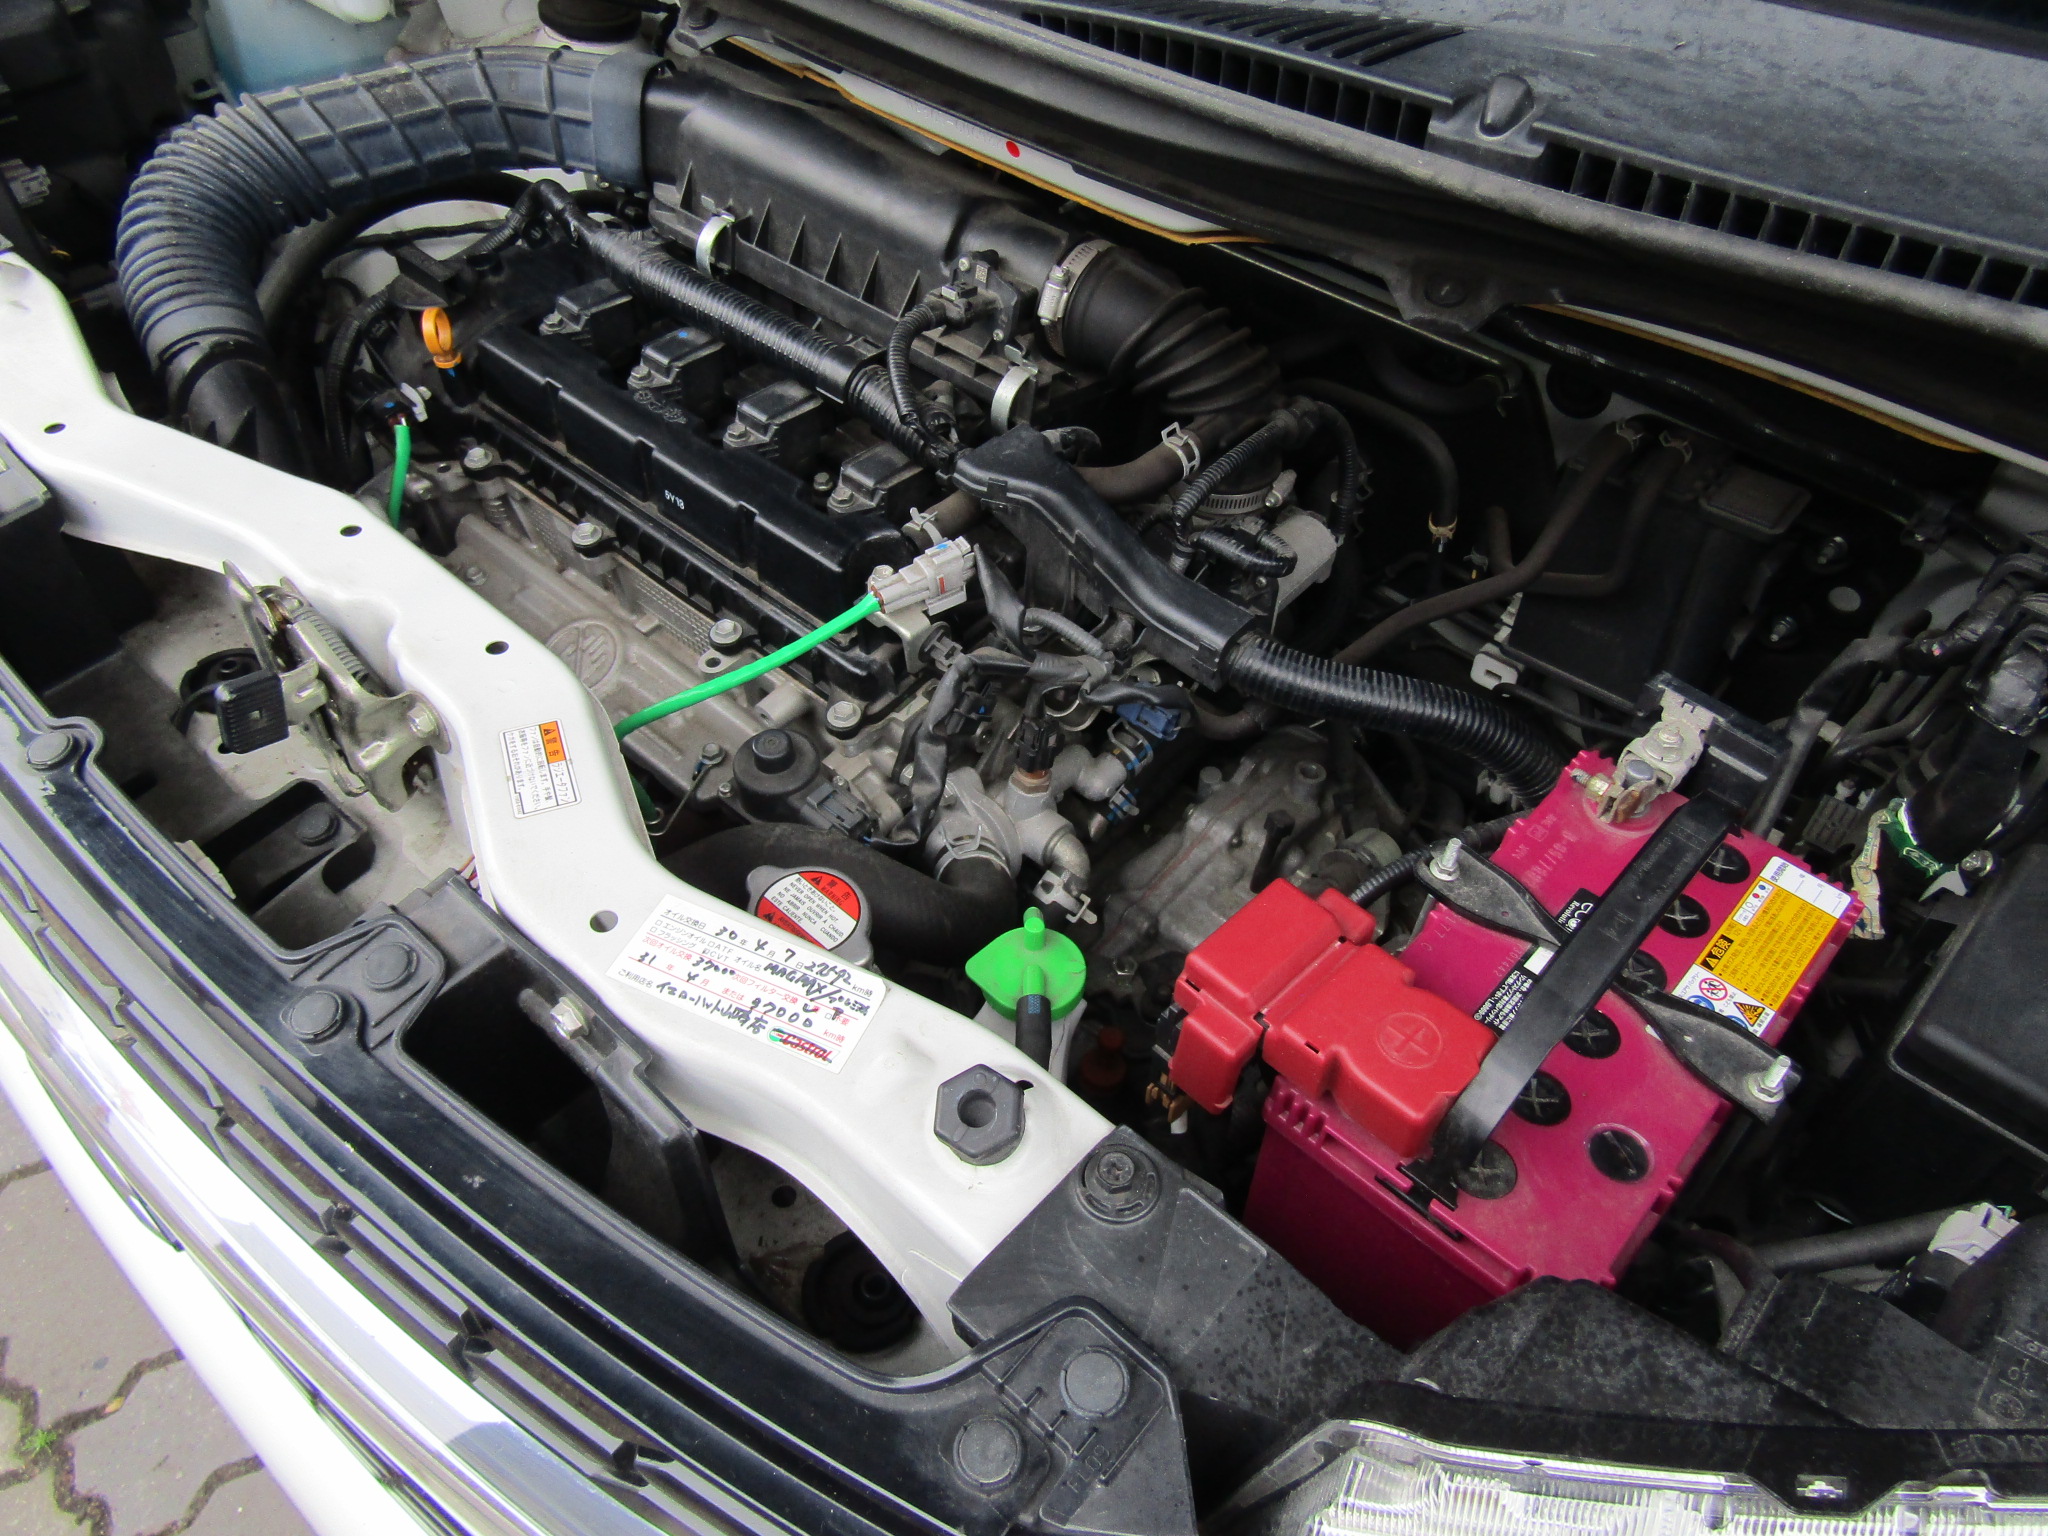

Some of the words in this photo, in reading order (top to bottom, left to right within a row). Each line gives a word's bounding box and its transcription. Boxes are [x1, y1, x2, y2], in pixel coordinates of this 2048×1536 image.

[770, 895, 783, 906] ESTE
[789, 893, 806, 906] JAMAIS
[806, 905, 823, 919] OUVRIR
[790, 882, 804, 895] NEVER
[804, 893, 816, 904] OPEN
[815, 903, 829, 915] WHEN
[821, 886, 845, 906] WARNING
[664, 909, 707, 930] オイル交換日
[777, 891, 785, 899] NO
[787, 899, 800, 911] ABRIR
[802, 911, 817, 925] NUNCA
[820, 926, 839, 943] CUANDO
[663, 922, 707, 944] エンジンオイル
[713, 943, 734, 954] ATF
[714, 926, 738, 940] 30
[740, 938, 748, 946] 年
[642, 936, 693, 961] 次回オイル交換
[658, 930, 698, 949] フラッシング
[709, 951, 730, 962] CVT
[754, 938, 768, 951] 4
[767, 950, 776, 958] 月
[1715, 938, 1732, 959] 危険
[733, 956, 762, 972] オイル名
[785, 948, 796, 962] 7
[795, 961, 804, 970] 日
[617, 968, 654, 988] ご利用店名
[701, 978, 710, 987] 月
[721, 986, 746, 1001] または
[732, 973, 798, 1005] 次回フィルター交換
[851, 984, 873, 997] km時
[823, 1029, 846, 1043] km時
